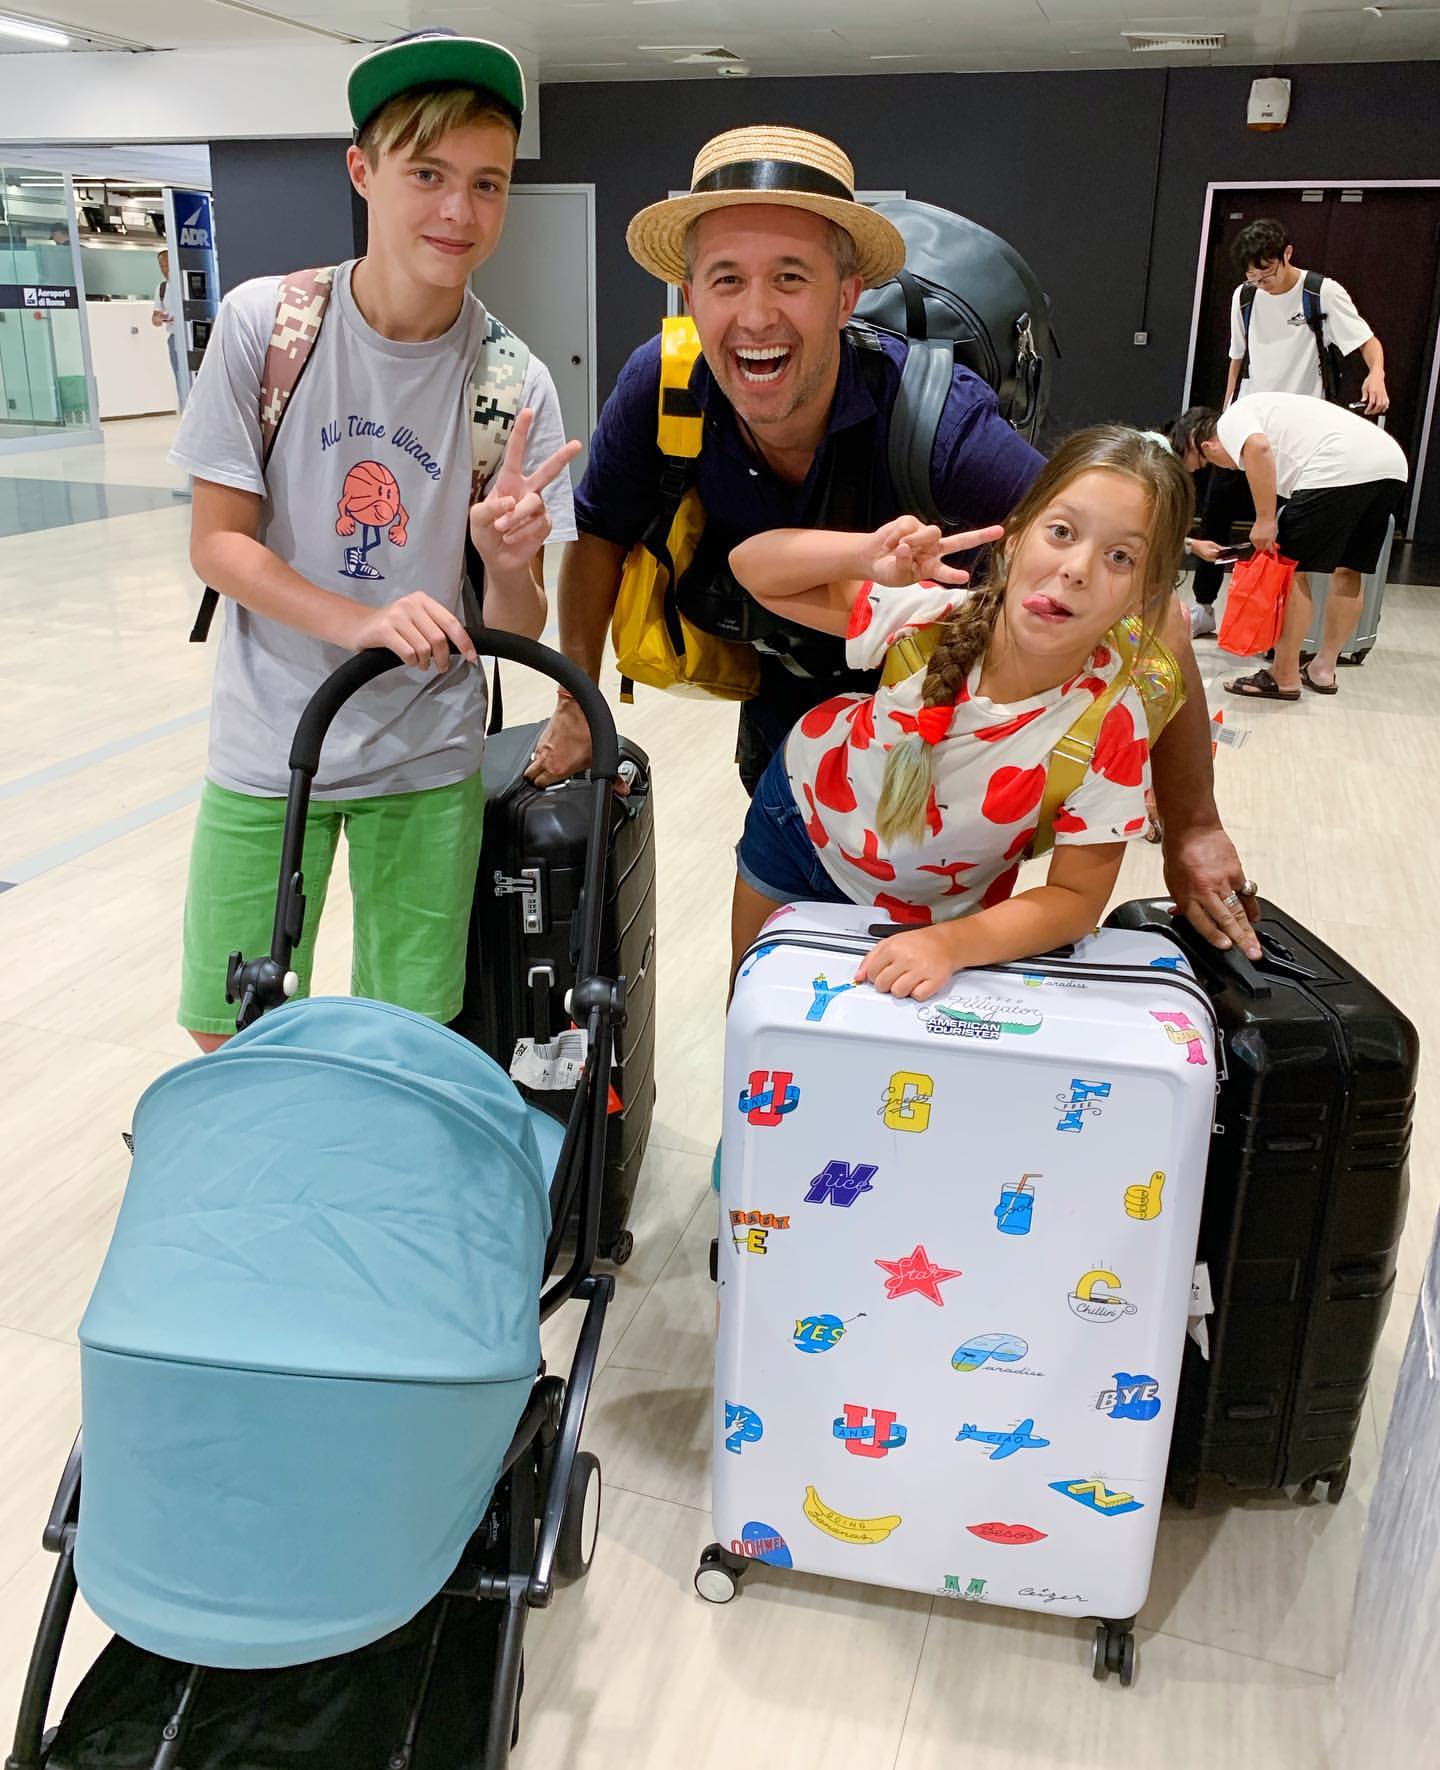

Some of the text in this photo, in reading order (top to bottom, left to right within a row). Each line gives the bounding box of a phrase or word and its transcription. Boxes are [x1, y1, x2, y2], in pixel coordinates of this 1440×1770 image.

[180, 228, 210, 246] ADR
[320, 415, 442, 481] All Time Winner
[927, 1017, 1000, 1031] AMERICAN
[927, 1024, 1000, 1040] TOURISTER
[885, 1258, 942, 1288] Star
[793, 1320, 847, 1344] YES
[1096, 1383, 1158, 1409] BYE
[986, 1433, 1023, 1444] CIAO
